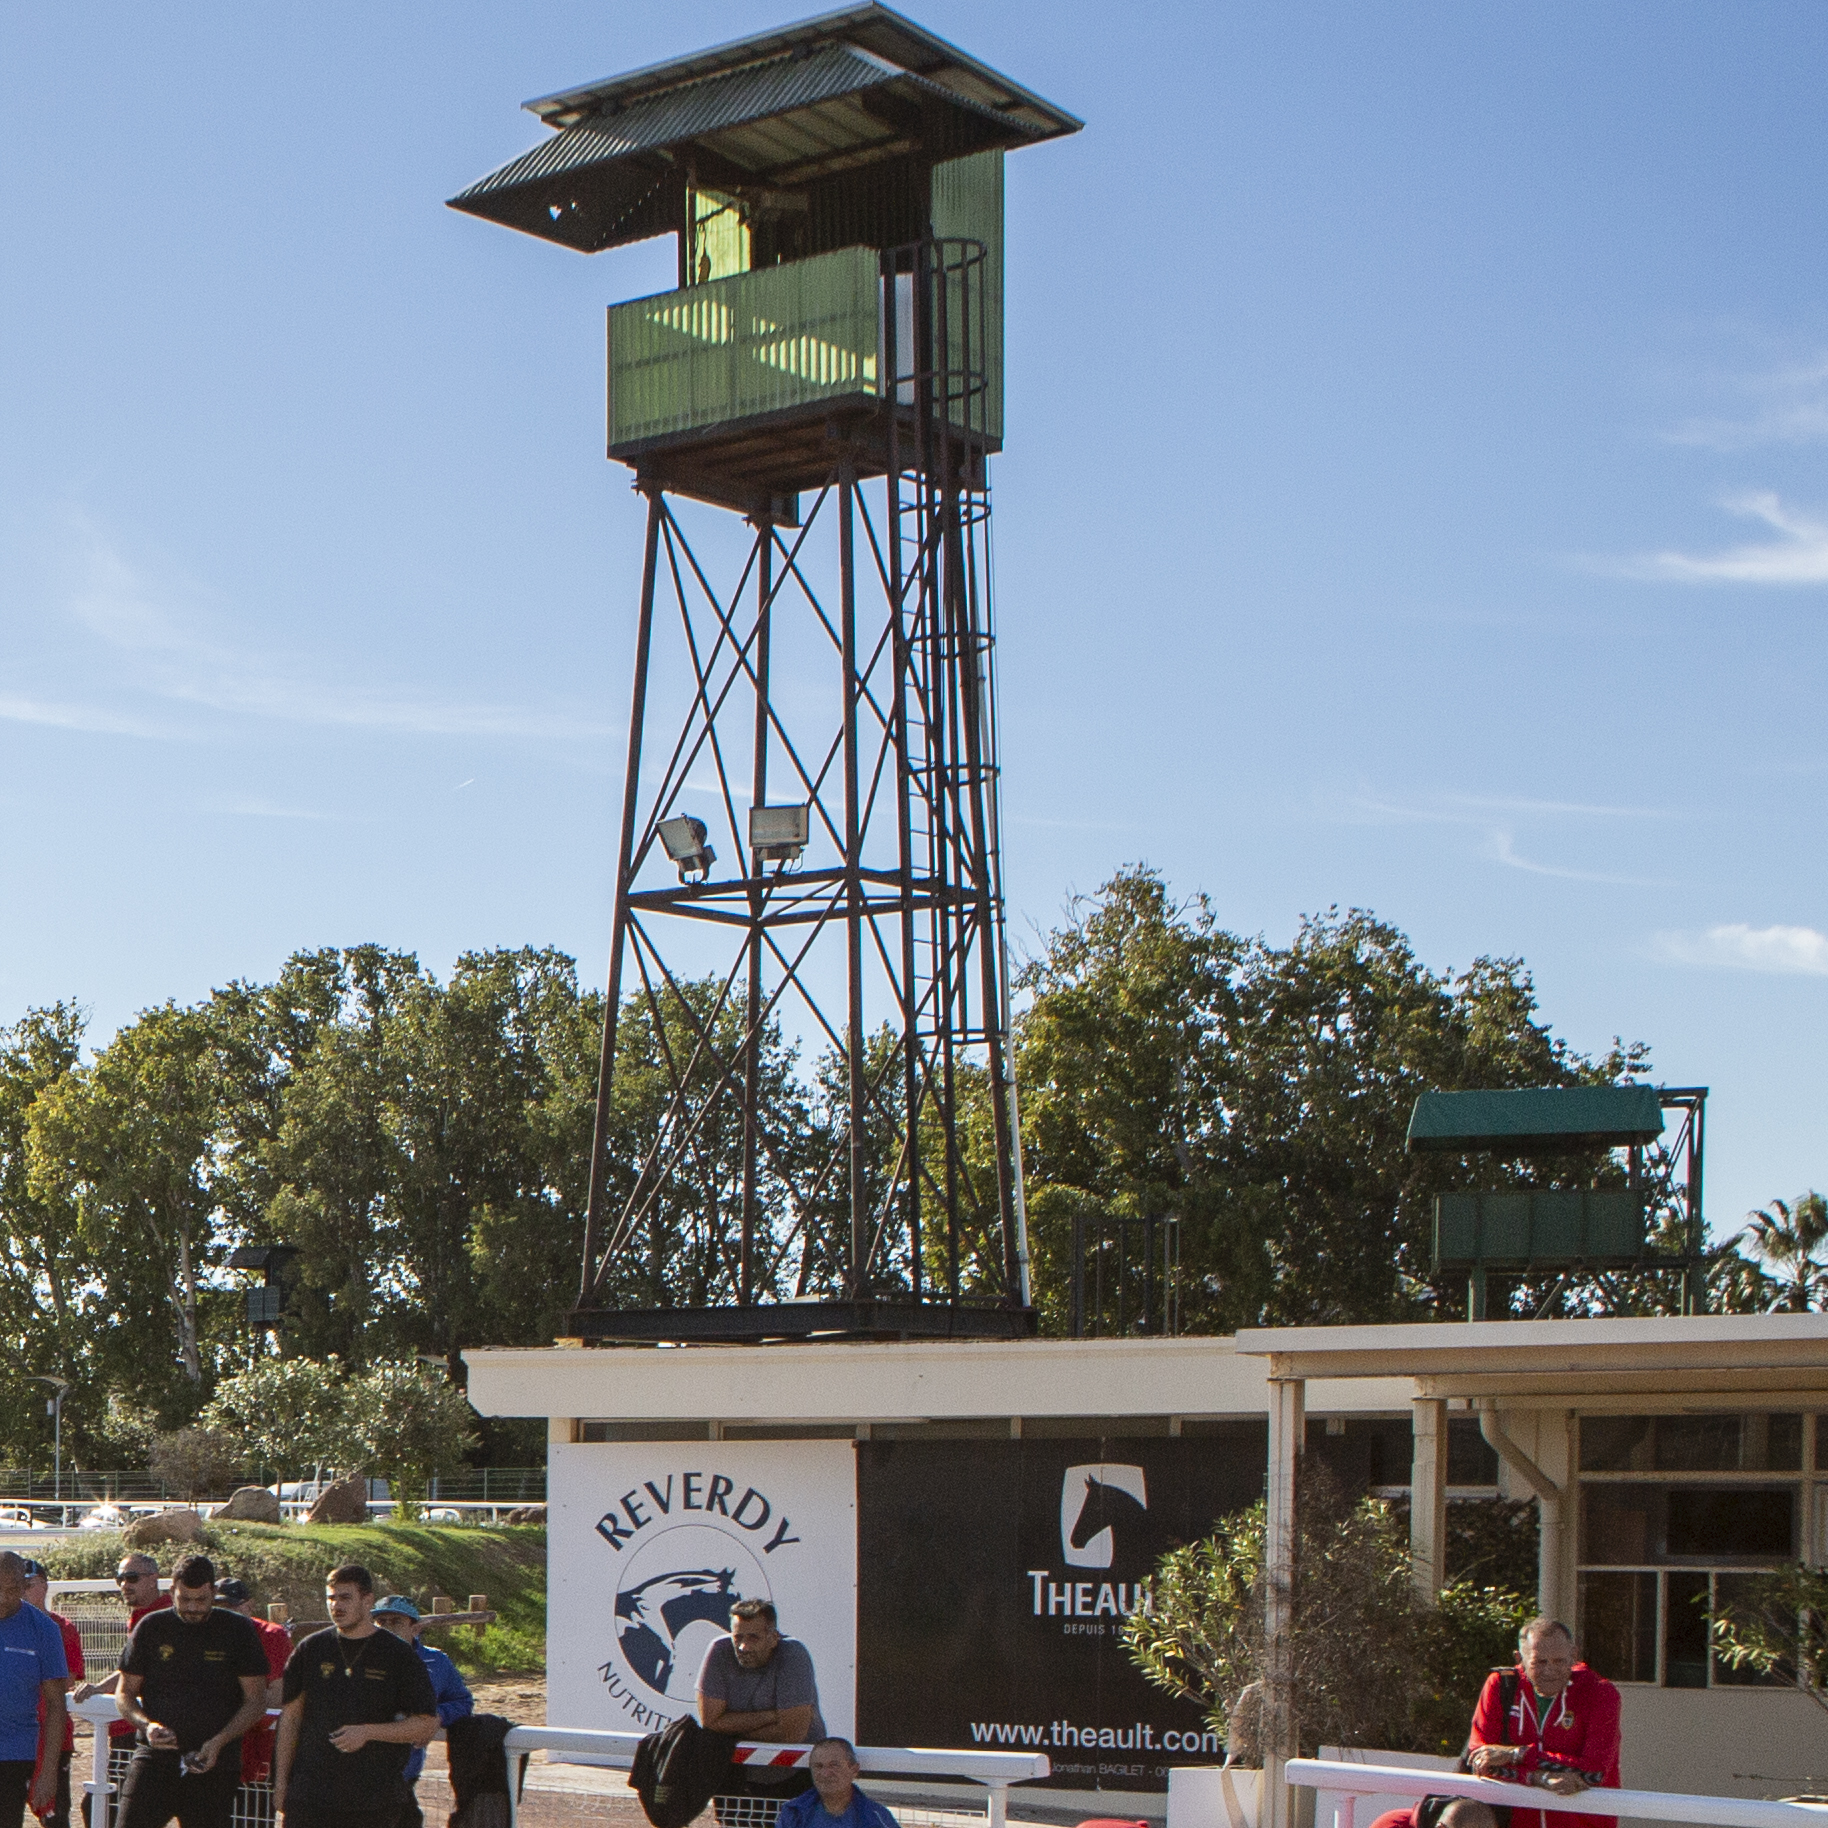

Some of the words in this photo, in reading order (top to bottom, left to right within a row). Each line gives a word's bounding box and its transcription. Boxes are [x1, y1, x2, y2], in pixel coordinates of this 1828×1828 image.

[594, 1472, 801, 1554] REVERDY
[1027, 1570, 1154, 1616] THEAUL
[1063, 1623, 1106, 1636] DEPUIS
[597, 1660, 672, 1732] NUTRIT
